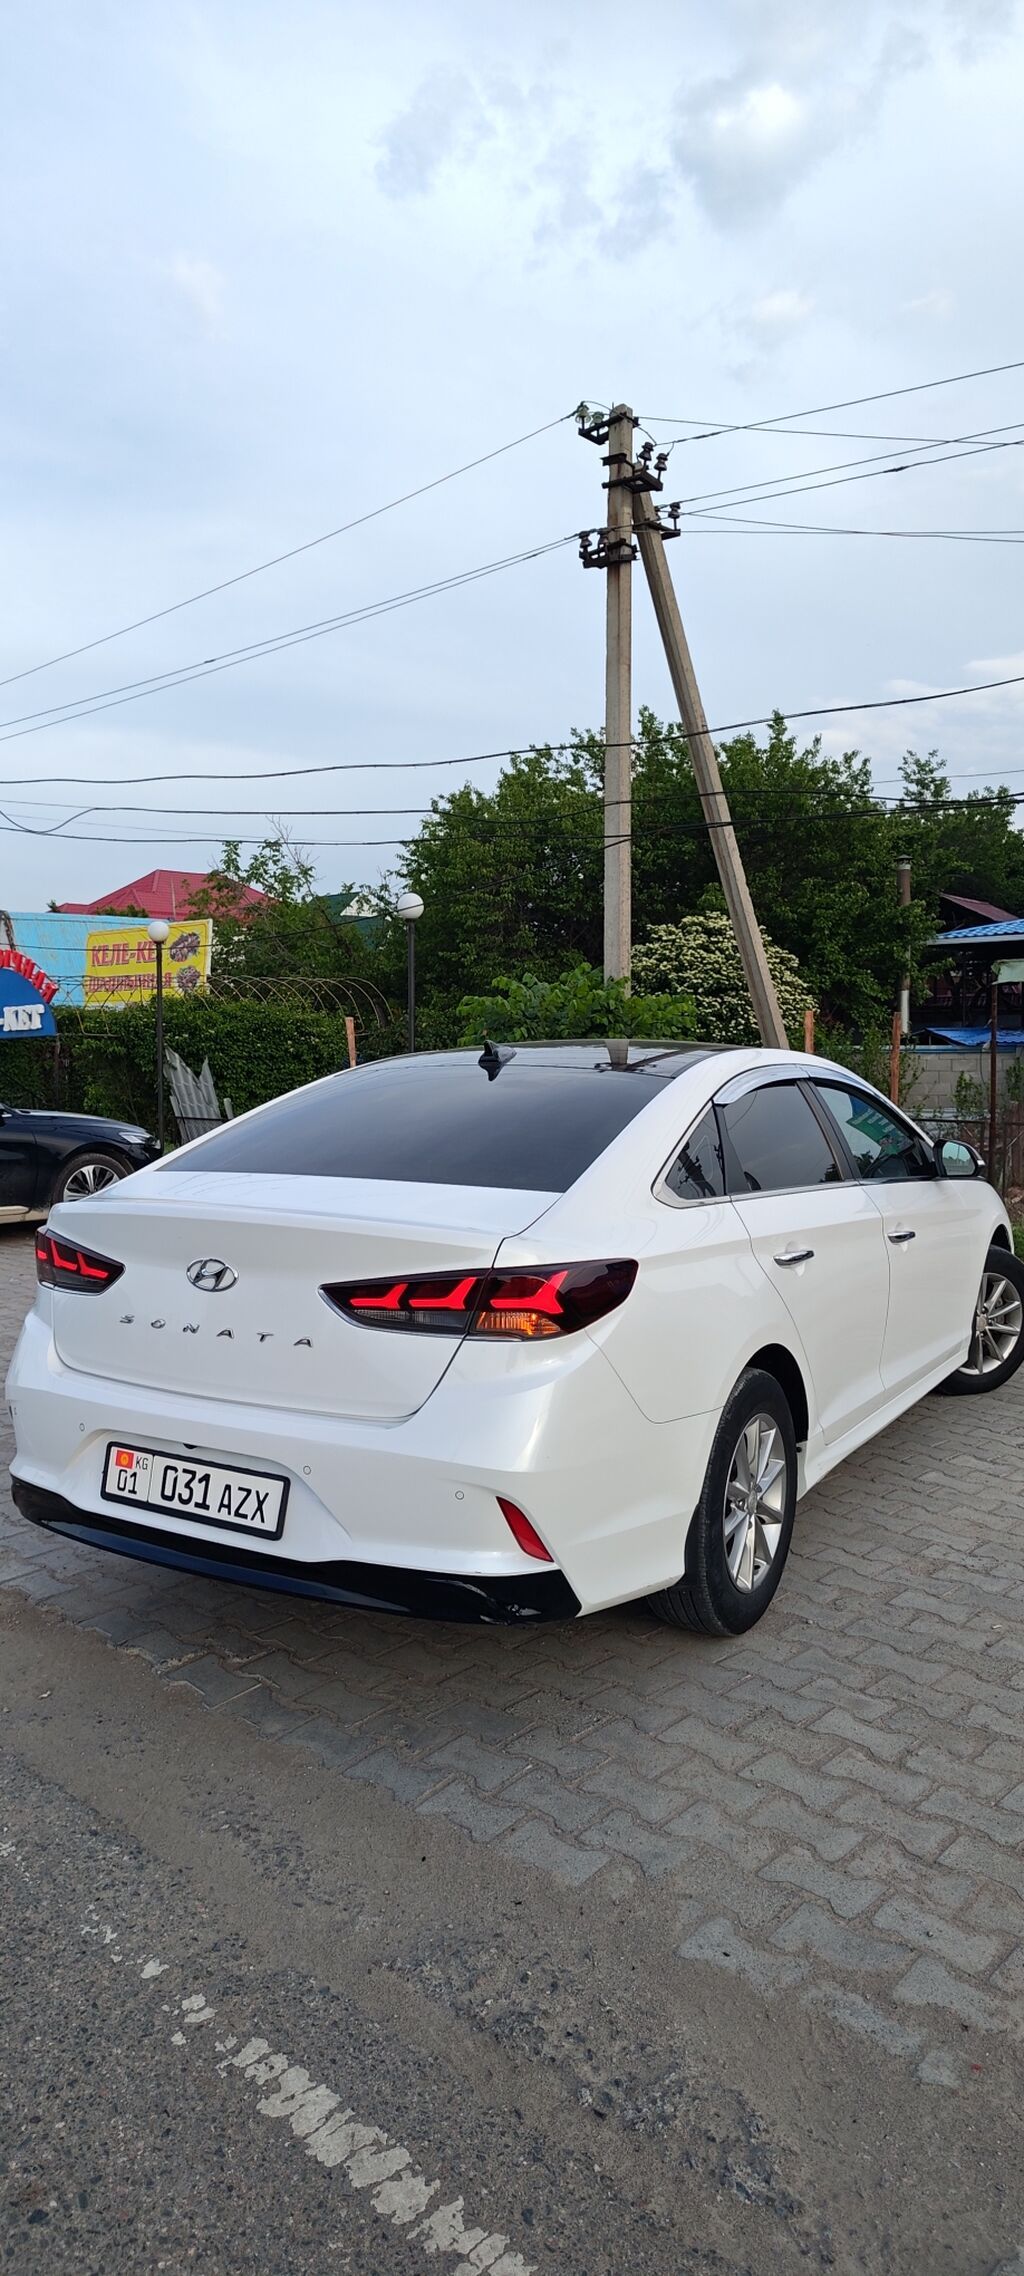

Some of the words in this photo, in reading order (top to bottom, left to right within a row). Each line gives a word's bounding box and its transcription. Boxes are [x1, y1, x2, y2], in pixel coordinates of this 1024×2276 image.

[91, 940, 159, 967] КЕЛЕ-КЕ
[119, 1313, 314, 1348] SONATA
[135, 1456, 149, 1470] KG
[117, 1470, 138, 1495] 01
[160, 1464, 211, 1511] 031
[217, 1484, 270, 1524] AZX
